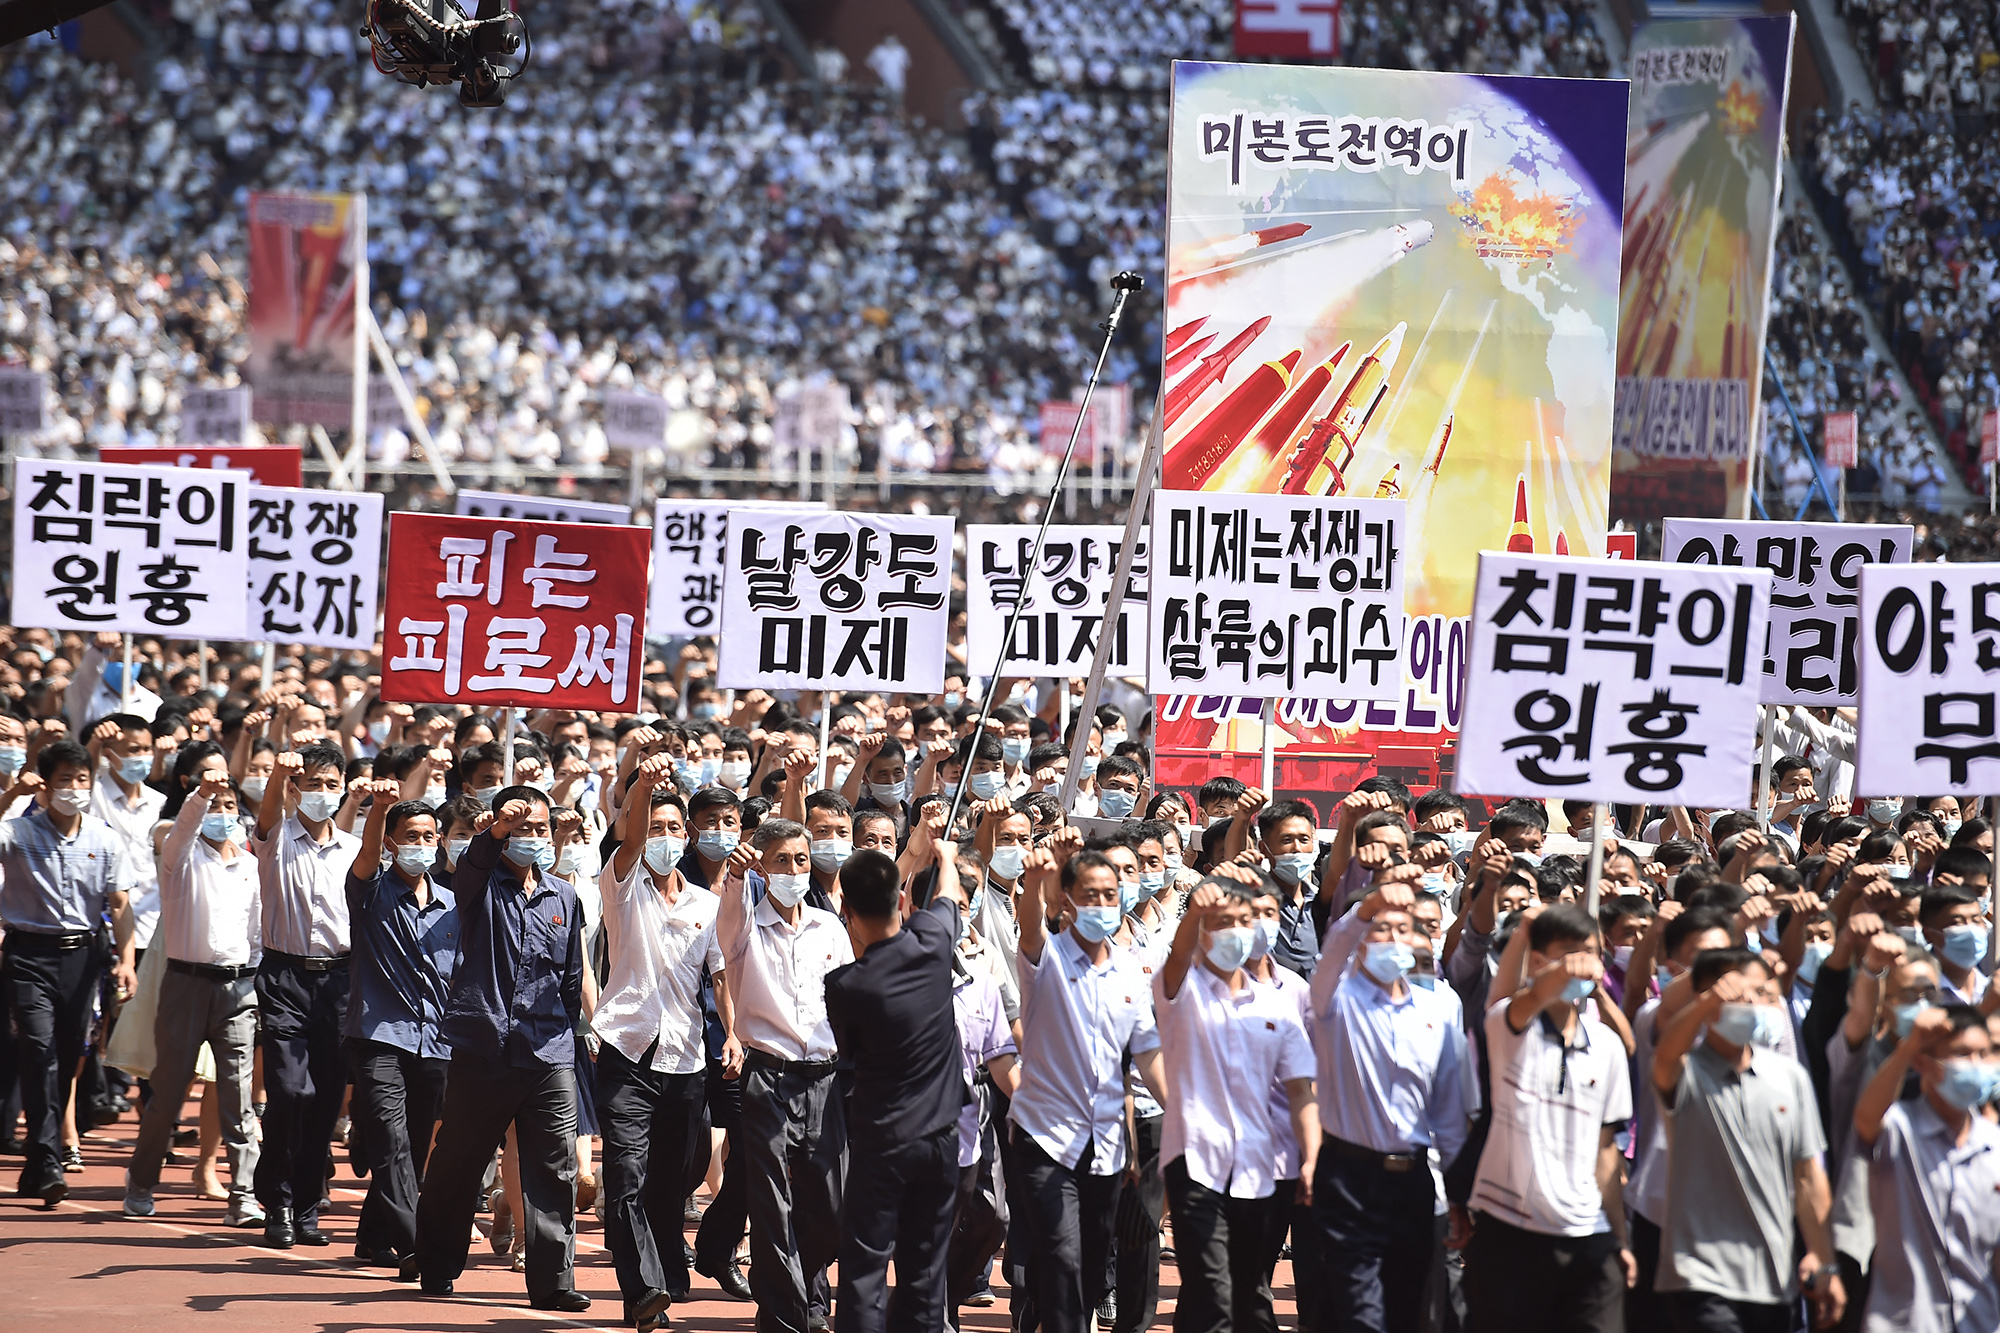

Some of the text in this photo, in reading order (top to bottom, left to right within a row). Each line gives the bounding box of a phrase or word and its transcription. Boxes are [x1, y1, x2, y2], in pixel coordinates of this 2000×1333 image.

[1203, 114, 1468, 185] 미본토전역이
[28, 470, 233, 552] 침략의
[249, 499, 359, 566] 전쟁
[45, 551, 208, 626] 원흉
[247, 571, 364, 639] 신자
[437, 530, 597, 609] 피는
[740, 524, 945, 611] 날강도
[982, 537, 1148, 607] 날강도
[389, 603, 635, 705] 피로써
[759, 614, 908, 682] 미제
[1002, 612, 1128, 666] 미제
[1490, 568, 1754, 686] 침략의
[1762, 616, 1859, 696] 리
[1502, 681, 1707, 792] 원흉
